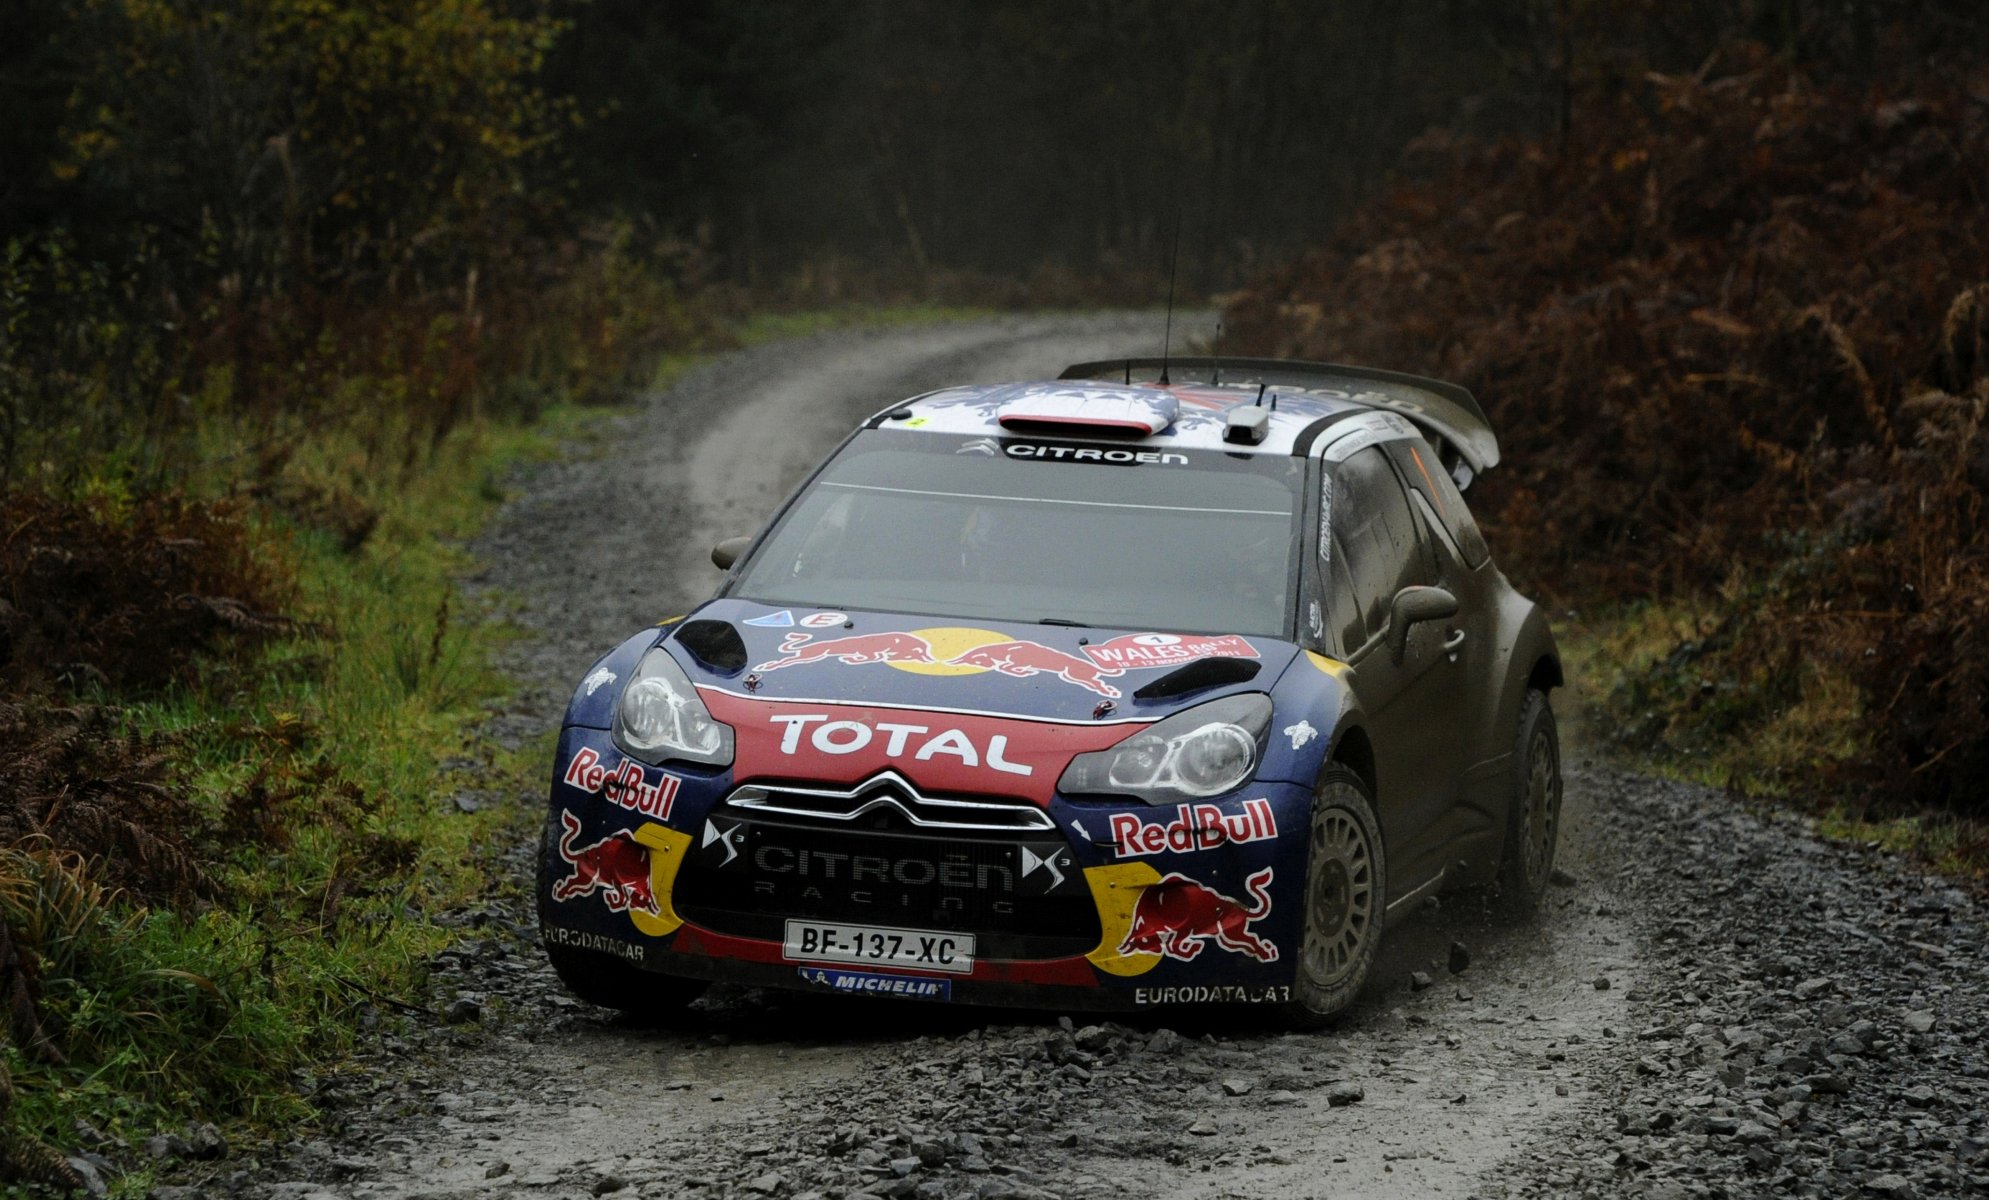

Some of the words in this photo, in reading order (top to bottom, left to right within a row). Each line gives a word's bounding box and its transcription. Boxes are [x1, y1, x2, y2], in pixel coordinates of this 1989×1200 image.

[1090, 645, 1190, 662] WALES
[1141, 659, 1155, 667] 13
[769, 714, 1033, 777] TOTAL
[754, 880, 1014, 914] RACING
[800, 927, 956, 965] BF-137-XC
[834, 975, 942, 995] MICHELIN
